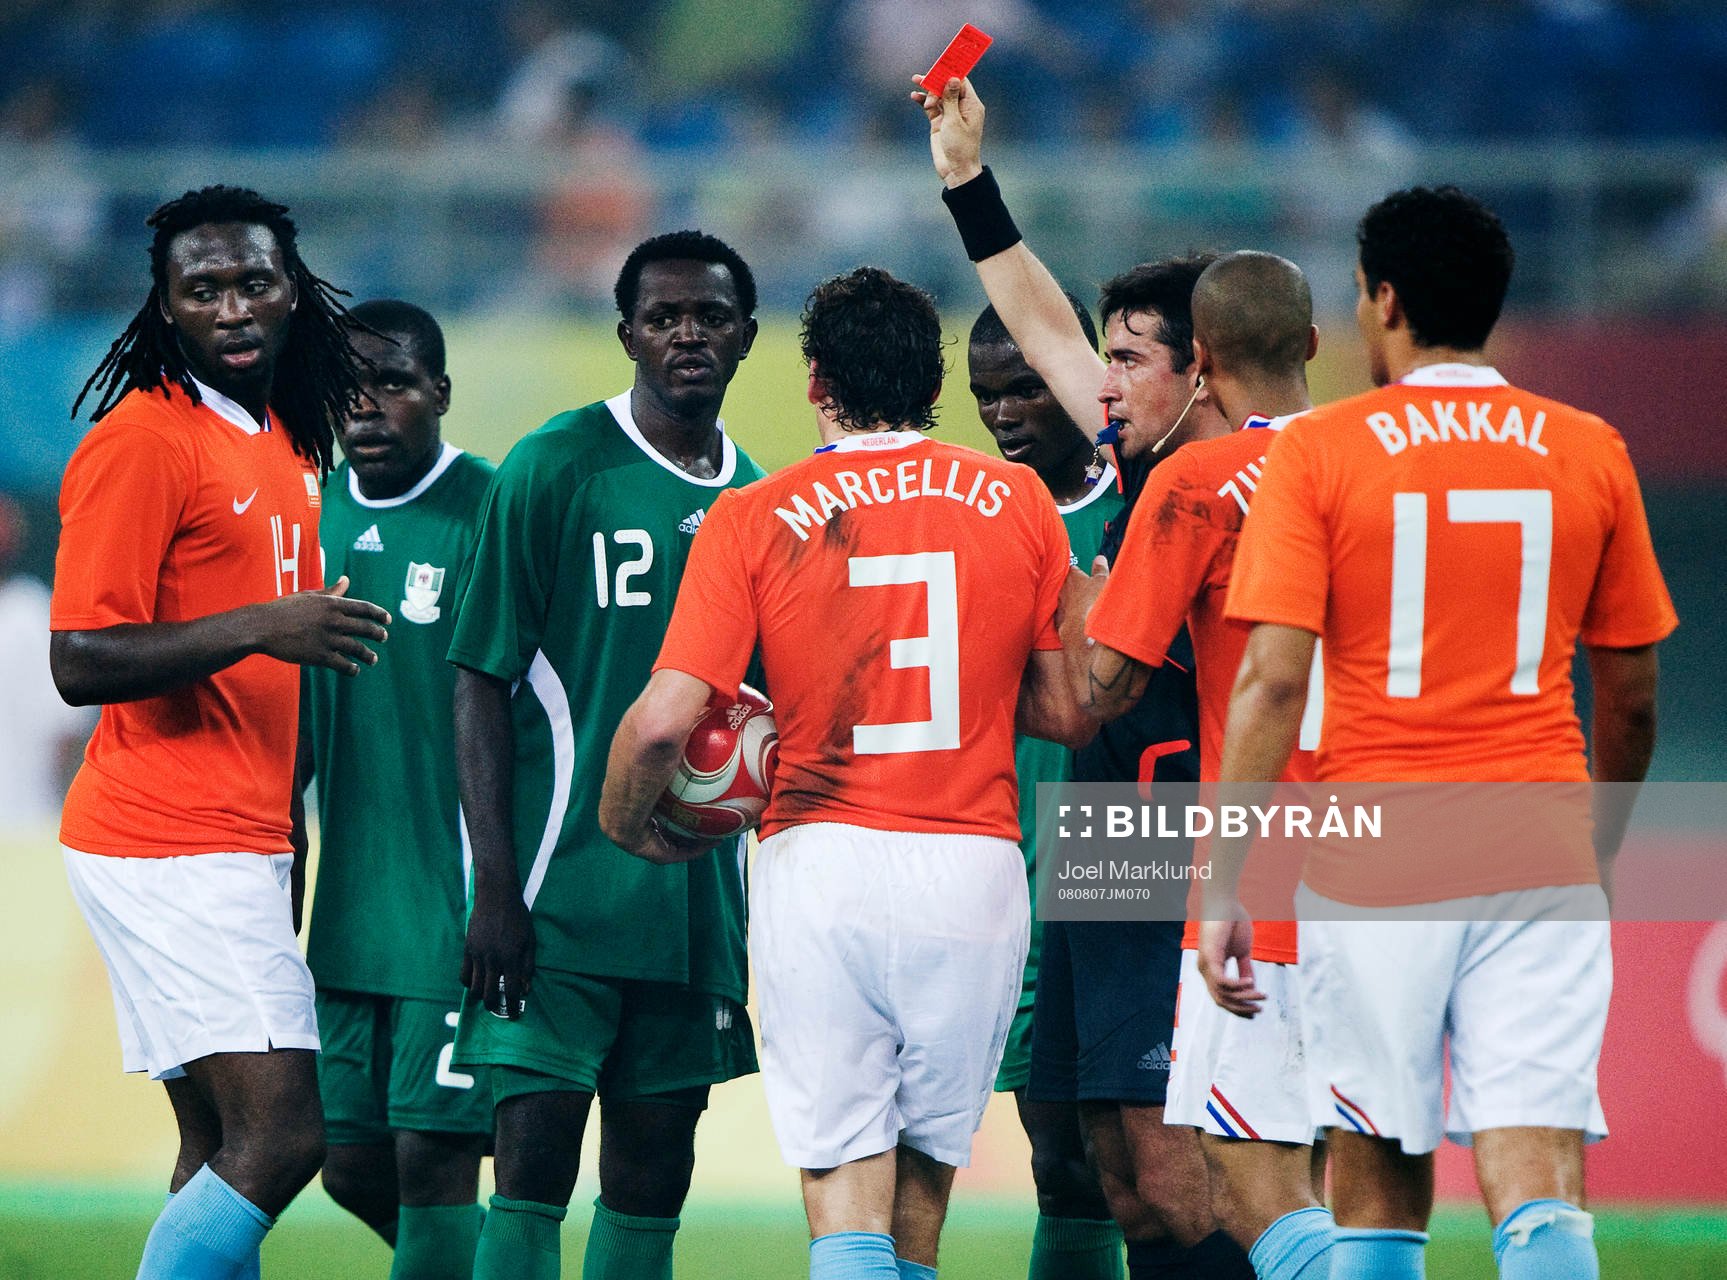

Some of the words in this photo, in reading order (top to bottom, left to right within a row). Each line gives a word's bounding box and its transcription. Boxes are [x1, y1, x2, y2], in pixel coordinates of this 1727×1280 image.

[1366, 400, 1549, 457] BAKKAL
[774, 459, 1011, 541] MARCELLIS
[592, 529, 654, 609] 12
[1386, 489, 1553, 698] 17
[848, 551, 960, 754] 3
[1136, 1060, 1171, 1070] adida
